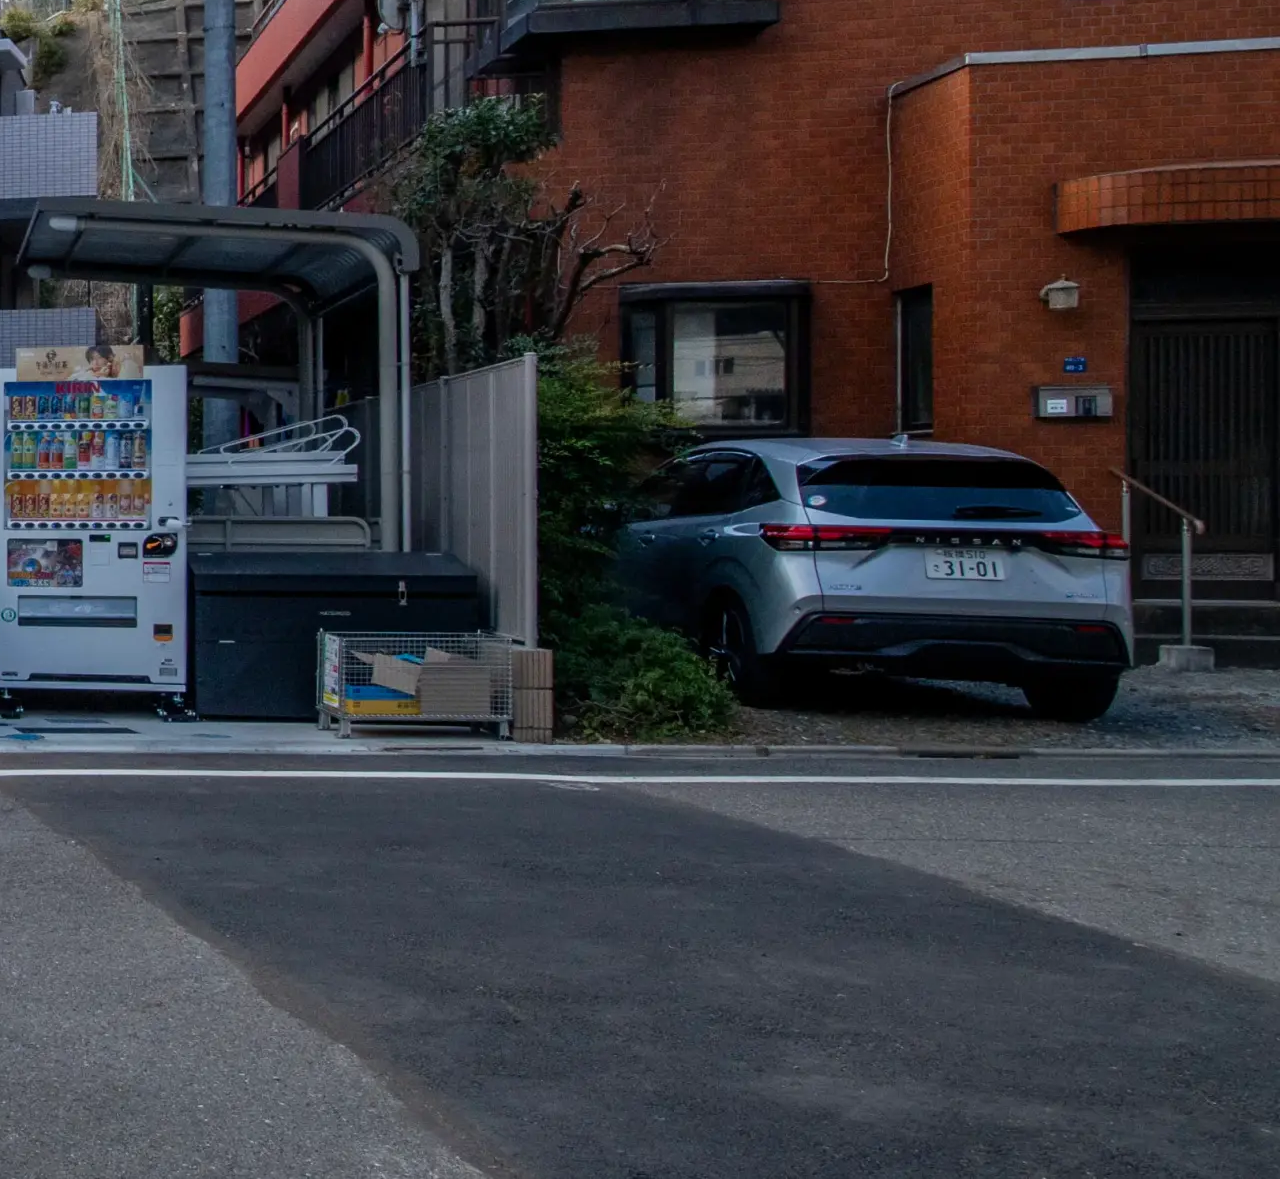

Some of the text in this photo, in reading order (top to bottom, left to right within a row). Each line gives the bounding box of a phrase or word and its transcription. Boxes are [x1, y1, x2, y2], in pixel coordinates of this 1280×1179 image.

[56, 381, 100, 394] KIRIN
[916, 537, 1021, 546] NISSAN
[944, 560, 997, 577] 31-01
